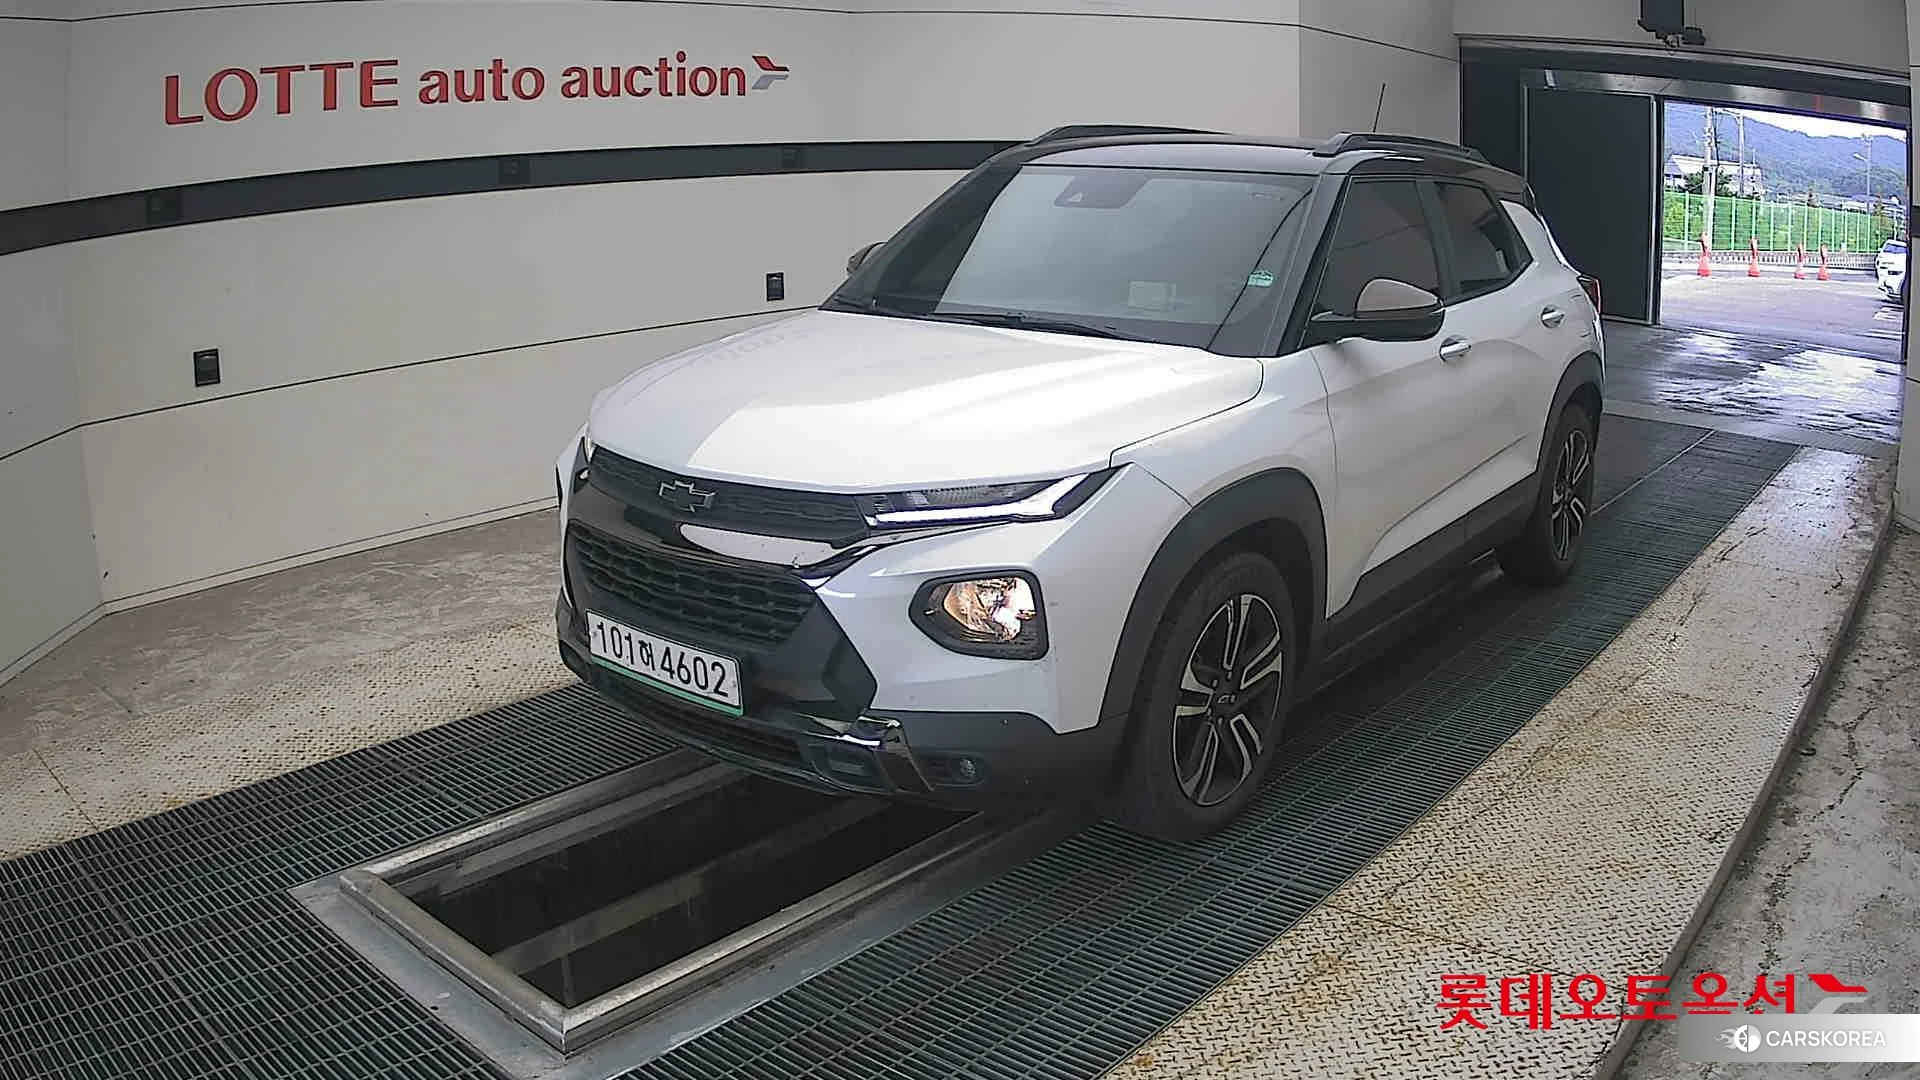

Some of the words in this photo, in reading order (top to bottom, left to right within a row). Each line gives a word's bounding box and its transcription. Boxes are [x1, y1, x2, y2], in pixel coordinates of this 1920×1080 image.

[165, 59, 398, 126] LOTTE
[418, 58, 546, 105] auto
[561, 50, 748, 99] auction
